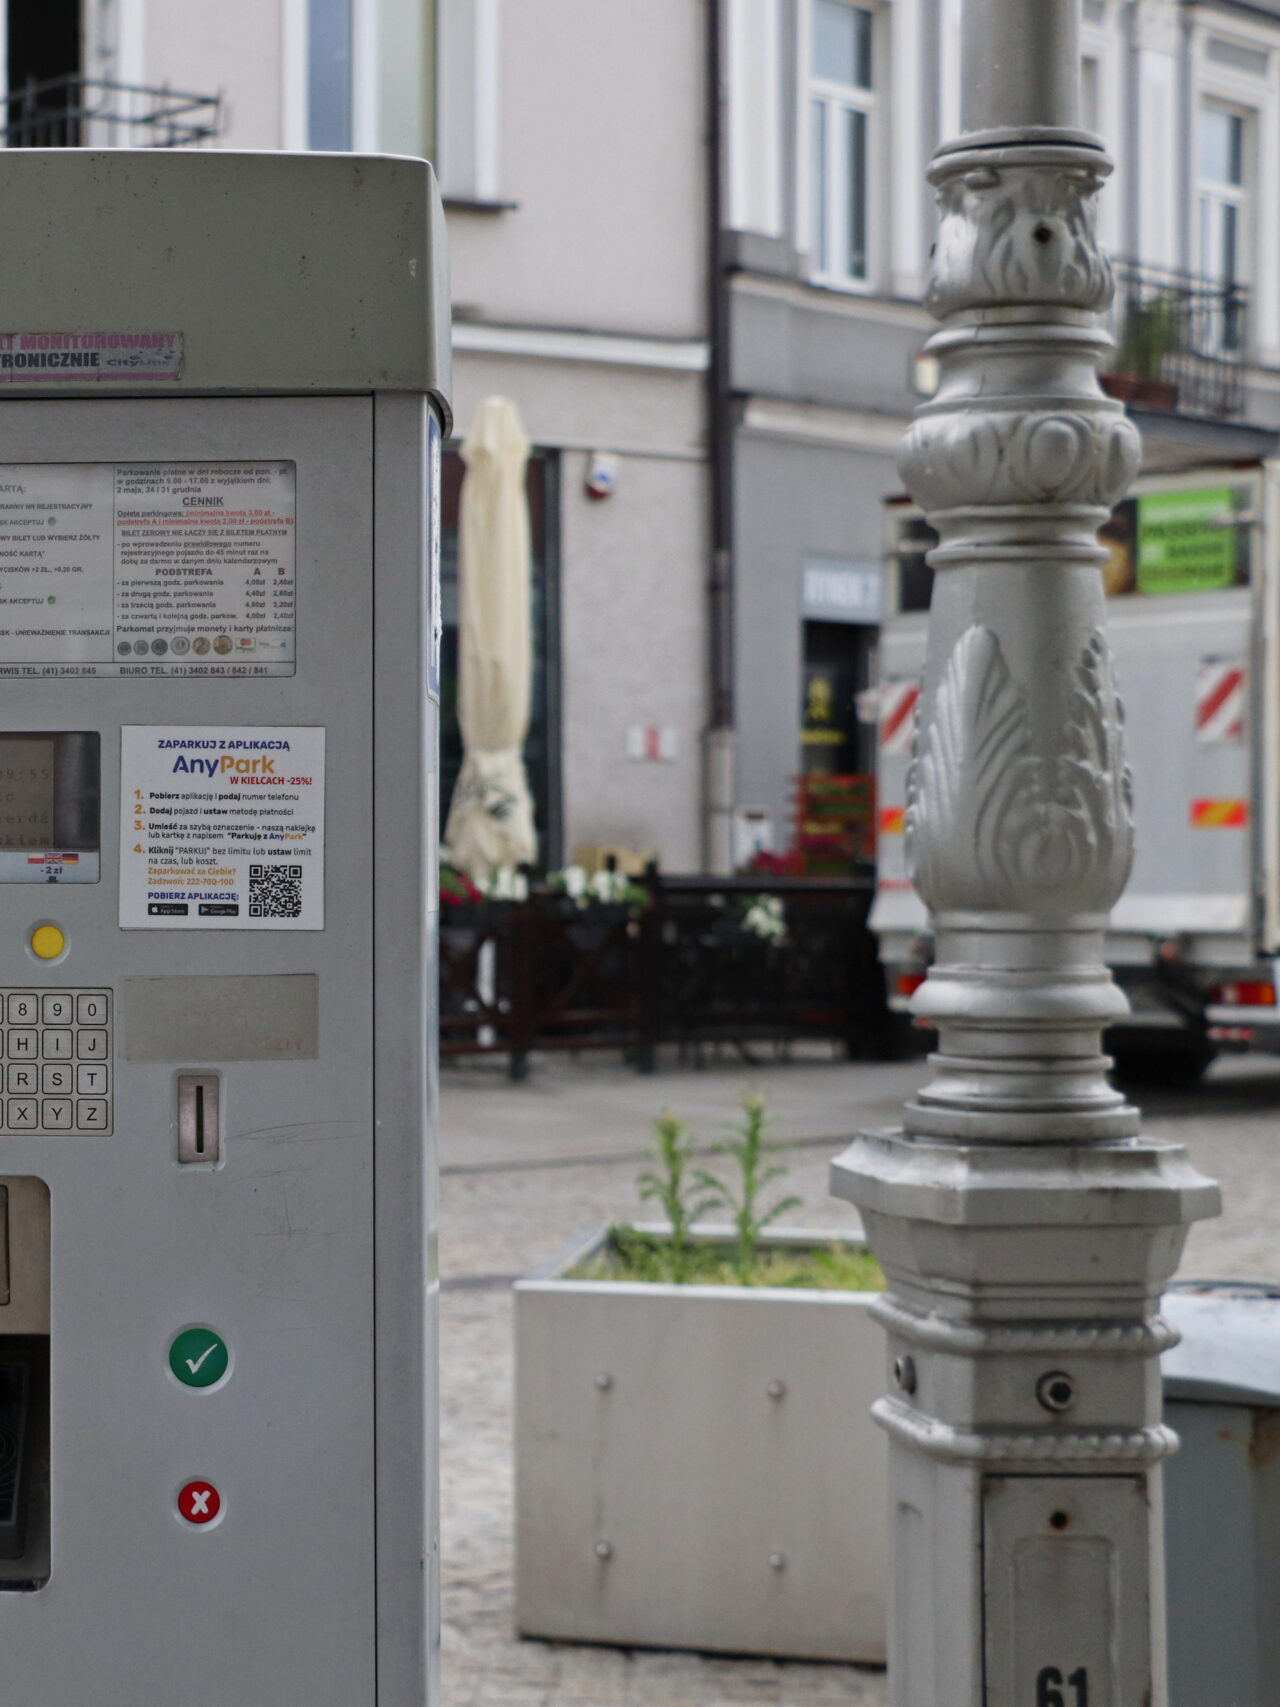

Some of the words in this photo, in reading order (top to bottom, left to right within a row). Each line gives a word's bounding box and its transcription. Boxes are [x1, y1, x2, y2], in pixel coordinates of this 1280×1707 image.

[20, 334, 175, 351] MONITOROWANY
[183, 497, 223, 506] CENNIK
[155, 568, 213, 576] PODSTREFA
[43, 667, 58, 676] (41)
[120, 667, 148, 675] BIURO
[151, 667, 169, 675] TEL.
[171, 666, 186, 676] (41)
[158, 740, 216, 749] ZAPARKUJ
[219, 740, 226, 749] Z
[228, 740, 290, 752] APLIKACJĄ
[172, 755, 275, 777] AnyPark
[230, 777, 239, 785] W
[241, 777, 285, 785] KIELCACH
[287, 777, 312, 785] -25%!
[134, 789, 144, 800] 1.
[149, 792, 180, 800] Pobierz
[181, 793, 213, 802] aplikację
[219, 793, 241, 802] podaj
[268, 793, 299, 801] telefonu
[134, 804, 146, 814] 2.
[149, 808, 172, 816] Dodaj
[174, 808, 198, 816] pojazd
[229, 808, 257, 817] metodę
[259, 808, 294, 817] płatności
[134, 821, 145, 830] 3.
[149, 822, 177, 830] Umieść
[189, 824, 211, 832] szybą
[262, 825, 284, 833] naszą
[286, 824, 316, 833] naklejkę
[161, 832, 185, 840] kartkę
[133, 844, 145, 854] 4.
[148, 847, 174, 856] Kliknij
[212, 847, 226, 855] bez
[228, 847, 251, 856] limitu
[253, 847, 265, 856] lub
[293, 848, 311, 857] limit
[160, 858, 178, 866] czas,
[181, 857, 193, 865] lub
[196, 857, 218, 865] koszt.
[148, 867, 196, 876] Zaparkować
[208, 867, 236, 875] Ciebie?
[148, 877, 185, 885] Zadzwoń:
[148, 892, 186, 900] POBIERZ
[187, 892, 239, 902] APLIKACJĘ:
[18, 1003, 27, 1016] 8
[53, 1003, 62, 1016] 9
[88, 1003, 96, 1016] 0
[18, 1038, 28, 1051] H
[56, 1038, 59, 1051] I
[88, 1038, 95, 1051] J
[17, 1073, 28, 1085] R
[52, 1073, 62, 1086] S
[87, 1073, 97, 1086] T
[17, 1108, 28, 1120] X
[52, 1108, 62, 1120] Y
[87, 1108, 97, 1121] Z
[1037, 1665, 1087, 1707] 61
